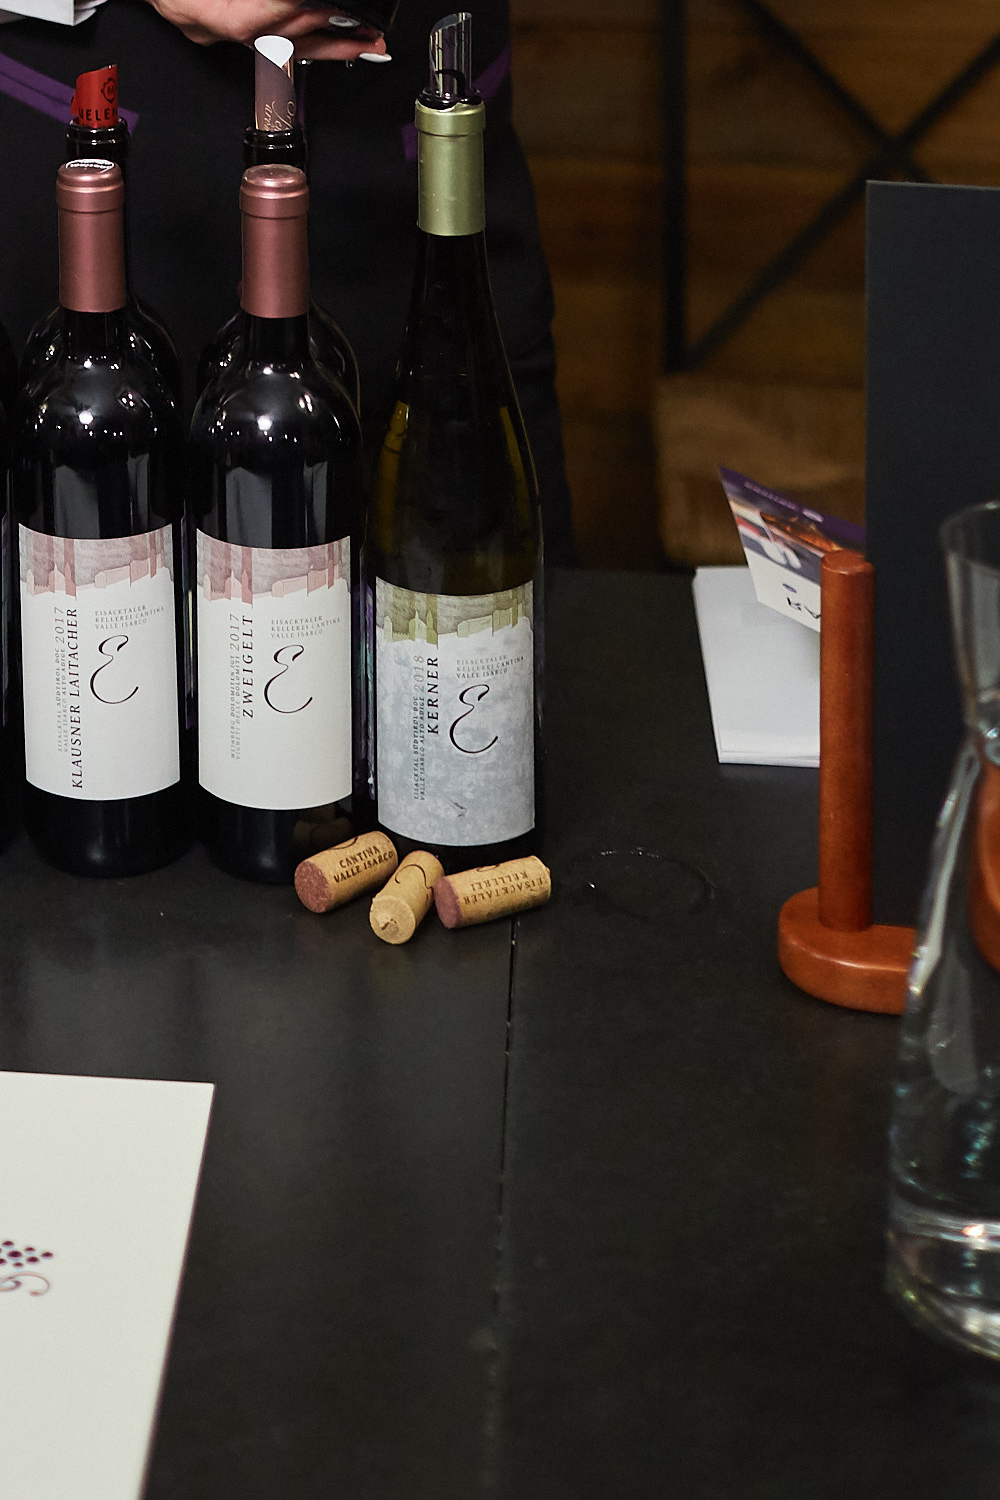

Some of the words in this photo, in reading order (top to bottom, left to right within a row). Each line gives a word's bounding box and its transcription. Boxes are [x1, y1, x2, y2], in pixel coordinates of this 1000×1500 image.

[53, 606, 65, 644] 2017
[230, 614, 240, 651] 2017
[66, 608, 80, 697] LAITACHER
[242, 615, 253, 719] ZWEIGELT
[413, 655, 425, 692] 2018
[427, 657, 439, 735] KERNER
[70, 705, 82, 789] KLAUSNER
[334, 866, 363, 883] VALLE
[363, 851, 394, 871] ISARCO
[339, 845, 381, 869] CANTINA
[463, 877, 543, 905] EISACKTALER
[470, 871, 528, 891] KELLEREI
